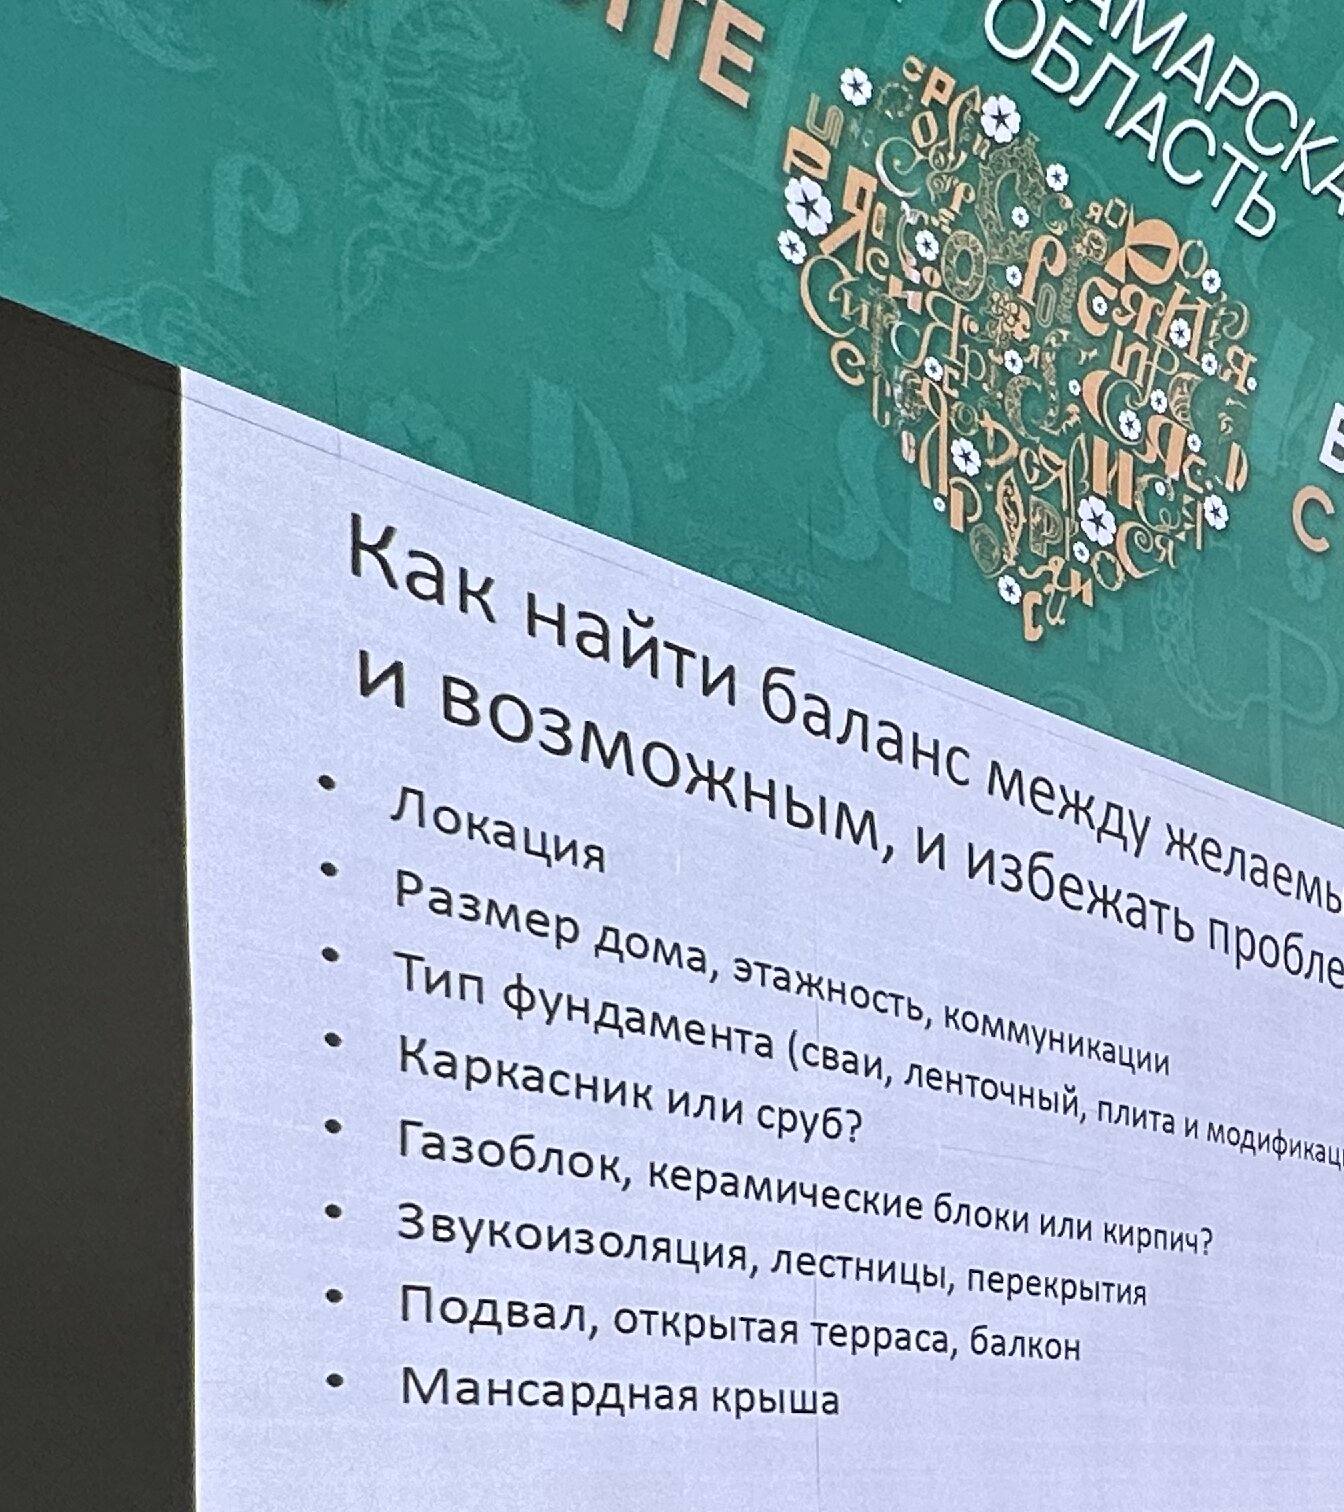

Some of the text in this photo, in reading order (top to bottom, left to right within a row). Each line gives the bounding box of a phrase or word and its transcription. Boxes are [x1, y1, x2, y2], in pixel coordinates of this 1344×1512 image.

[983, 0, 1278, 239] ОБЛАСТЬ
[1291, 484, 1336, 553] С
[350, 513, 496, 624] Как
[527, 591, 736, 707] найти
[762, 666, 970, 787] баланс
[987, 759, 1152, 858] между
[359, 649, 405, 709] и
[441, 674, 895, 865] возможным,
[916, 826, 946, 872] и
[967, 841, 1195, 944] избежать
[390, 785, 606, 874] Локация
[396, 869, 1171, 1076] Размер дома, этажность, коммуникации
[393, 950, 484, 1004] Тип
[503, 973, 774, 1060] фундамента
[787, 1029, 893, 1088] (сваи,
[904, 1060, 1087, 1125] ленточный,
[1097, 1100, 1176, 1137] плита
[1184, 1114, 1199, 1140] и
[399, 1034, 863, 1145] Каркасник или сруб?
[399, 1119, 1214, 1257] Газоблок, керамические блоки или кирпич?
[397, 1202, 1147, 1308] Звукоизоляция, лестницы, перекрытия
[400, 1284, 1081, 1362] Подвал, открытая терраса, балкон
[400, 1365, 841, 1419] Мансардная крыша
